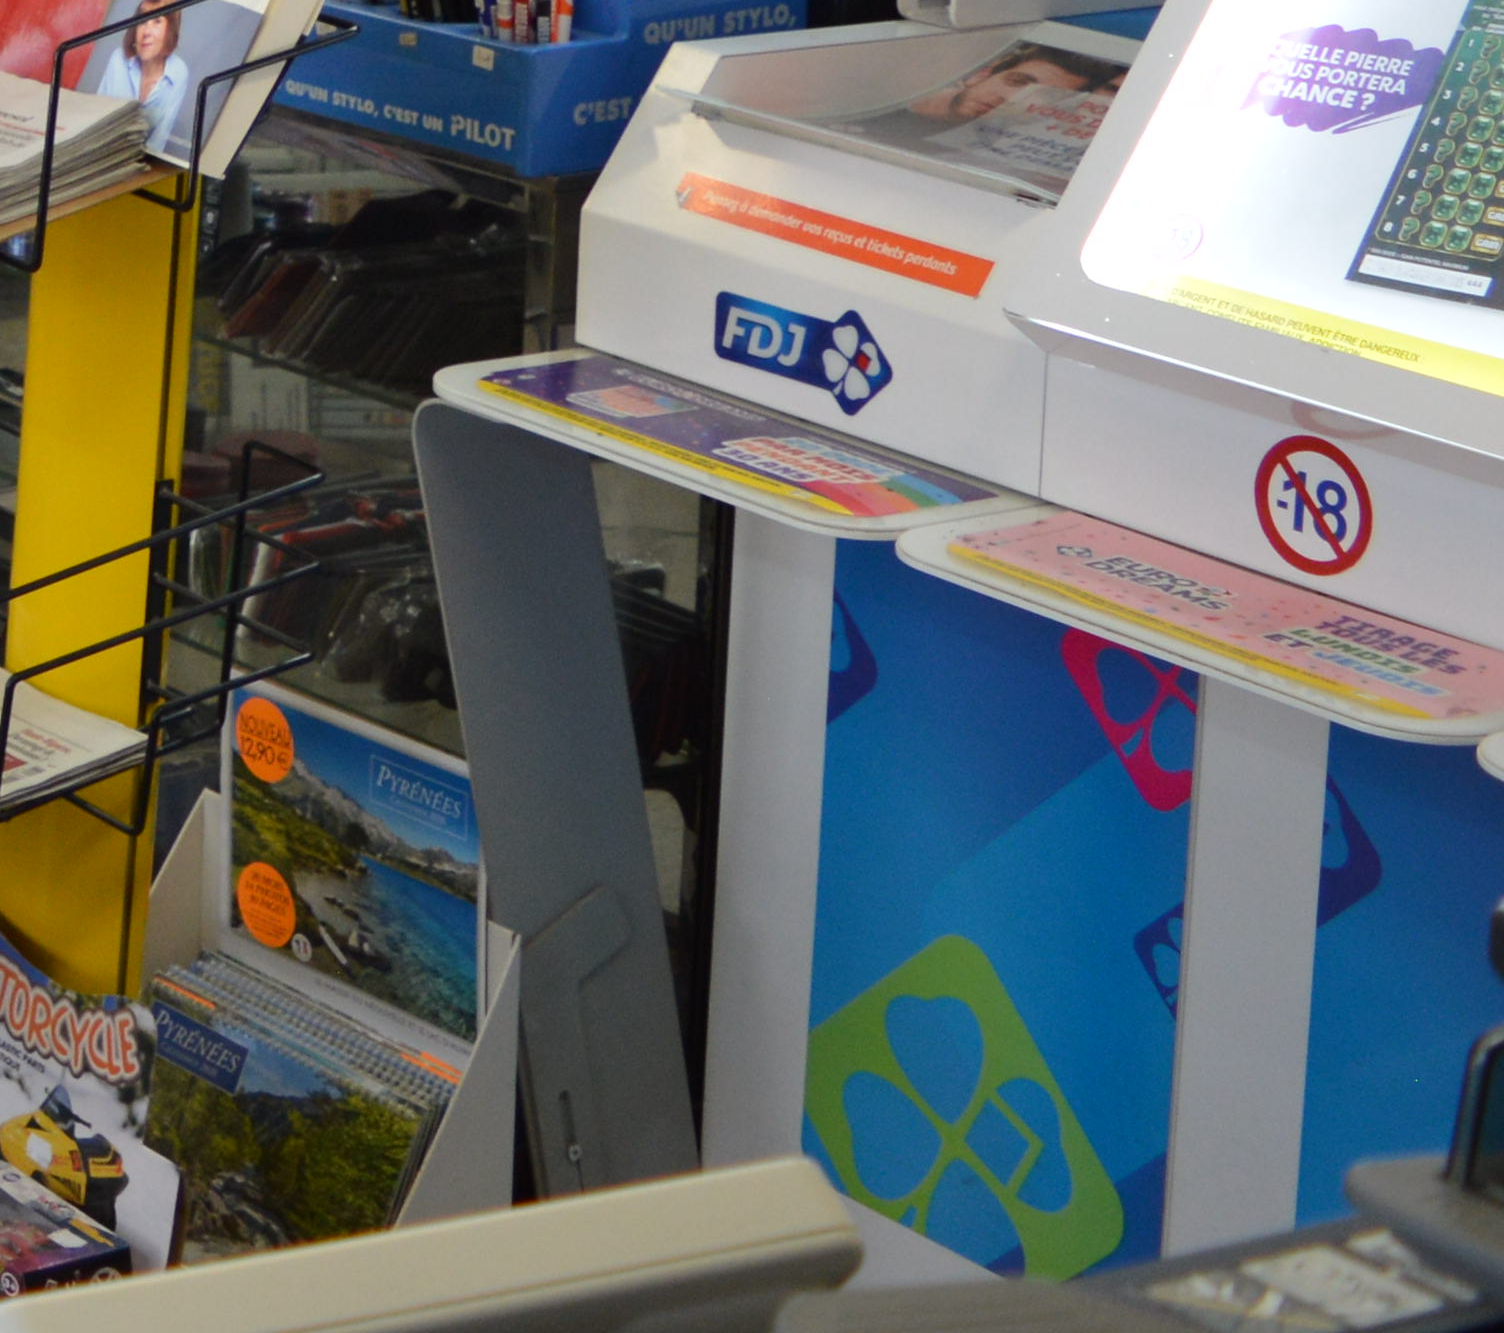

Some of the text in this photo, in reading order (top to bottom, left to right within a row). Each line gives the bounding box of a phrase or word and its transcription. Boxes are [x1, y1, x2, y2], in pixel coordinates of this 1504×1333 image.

[644, 4, 796, 45] QU'UN STYLO,
[1315, 68, 1406, 96] PORTERA
[1345, 51, 1414, 76] PIERRE
[574, 98, 634, 127] C'EST
[1259, 79, 1357, 109] CHANCE
[332, 90, 378, 118] STYLO,
[384, 103, 419, 128] C'EST
[423, 113, 443, 133] UN
[451, 114, 516, 152] PILOT
[748, 203, 803, 229] demander
[823, 226, 852, 249] reçus
[854, 237, 867, 250] et
[867, 238, 904, 261] tickets
[903, 250, 957, 275] perdants
[722, 306, 807, 367] FDJ
[1086, 561, 1229, 611] DREAMS
[1107, 555, 1192, 587] EURO
[1290, 628, 1420, 674] LUNDIS
[1332, 614, 1460, 660] TIRAGE
[1314, 651, 1442, 696] JEUDIS
[376, 764, 462, 819] PYRÉNÉES
[156, 1009, 241, 1073] PYRÉNÉES
